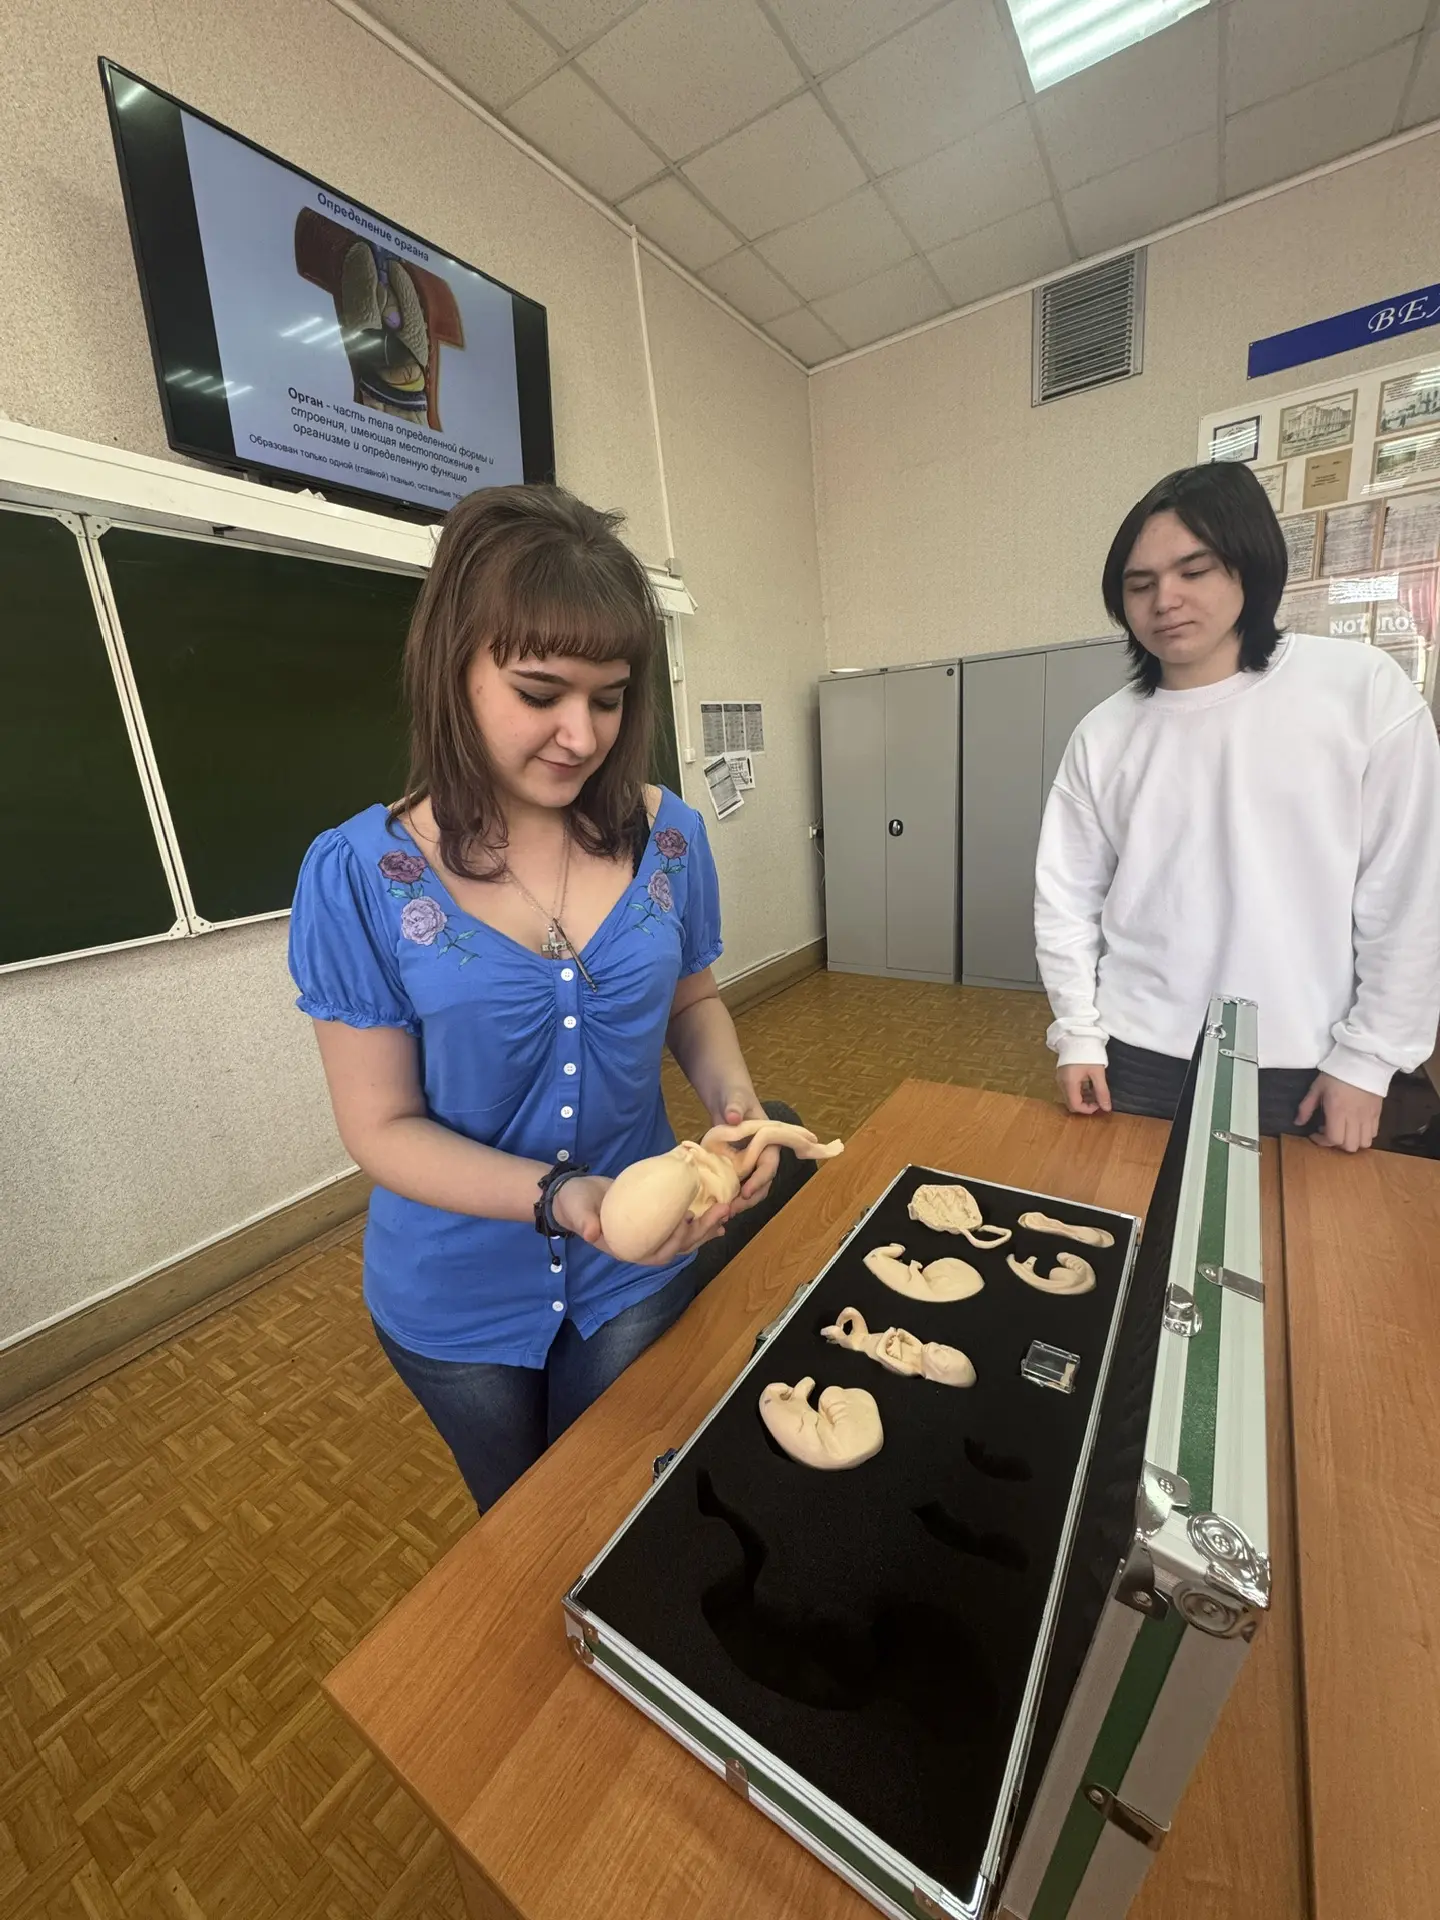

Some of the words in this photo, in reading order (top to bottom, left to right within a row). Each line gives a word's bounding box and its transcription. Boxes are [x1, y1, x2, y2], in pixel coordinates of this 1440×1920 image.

[317, 192, 392, 241] Определение
[394, 237, 429, 262] органа
[288, 387, 324, 408] Орган
[333, 404, 366, 422] часть
[368, 416, 394, 432] тела
[396, 425, 457, 453] определенной
[459, 445, 488, 463] формы
[290, 406, 347, 433] строения,
[350, 425, 397, 448] имеющая
[399, 440, 474, 472] местоположение
[293, 423, 351, 448] организме
[353, 441, 360, 450] и
[361, 443, 429, 472] определенную
[430, 464, 468, 483] функцию
[249, 433, 299, 455] Образован
[300, 449, 328, 464] только
[329, 457, 354, 471] одной
[354, 463, 389, 481] (главной)
[390, 473, 417, 489] тканью,
